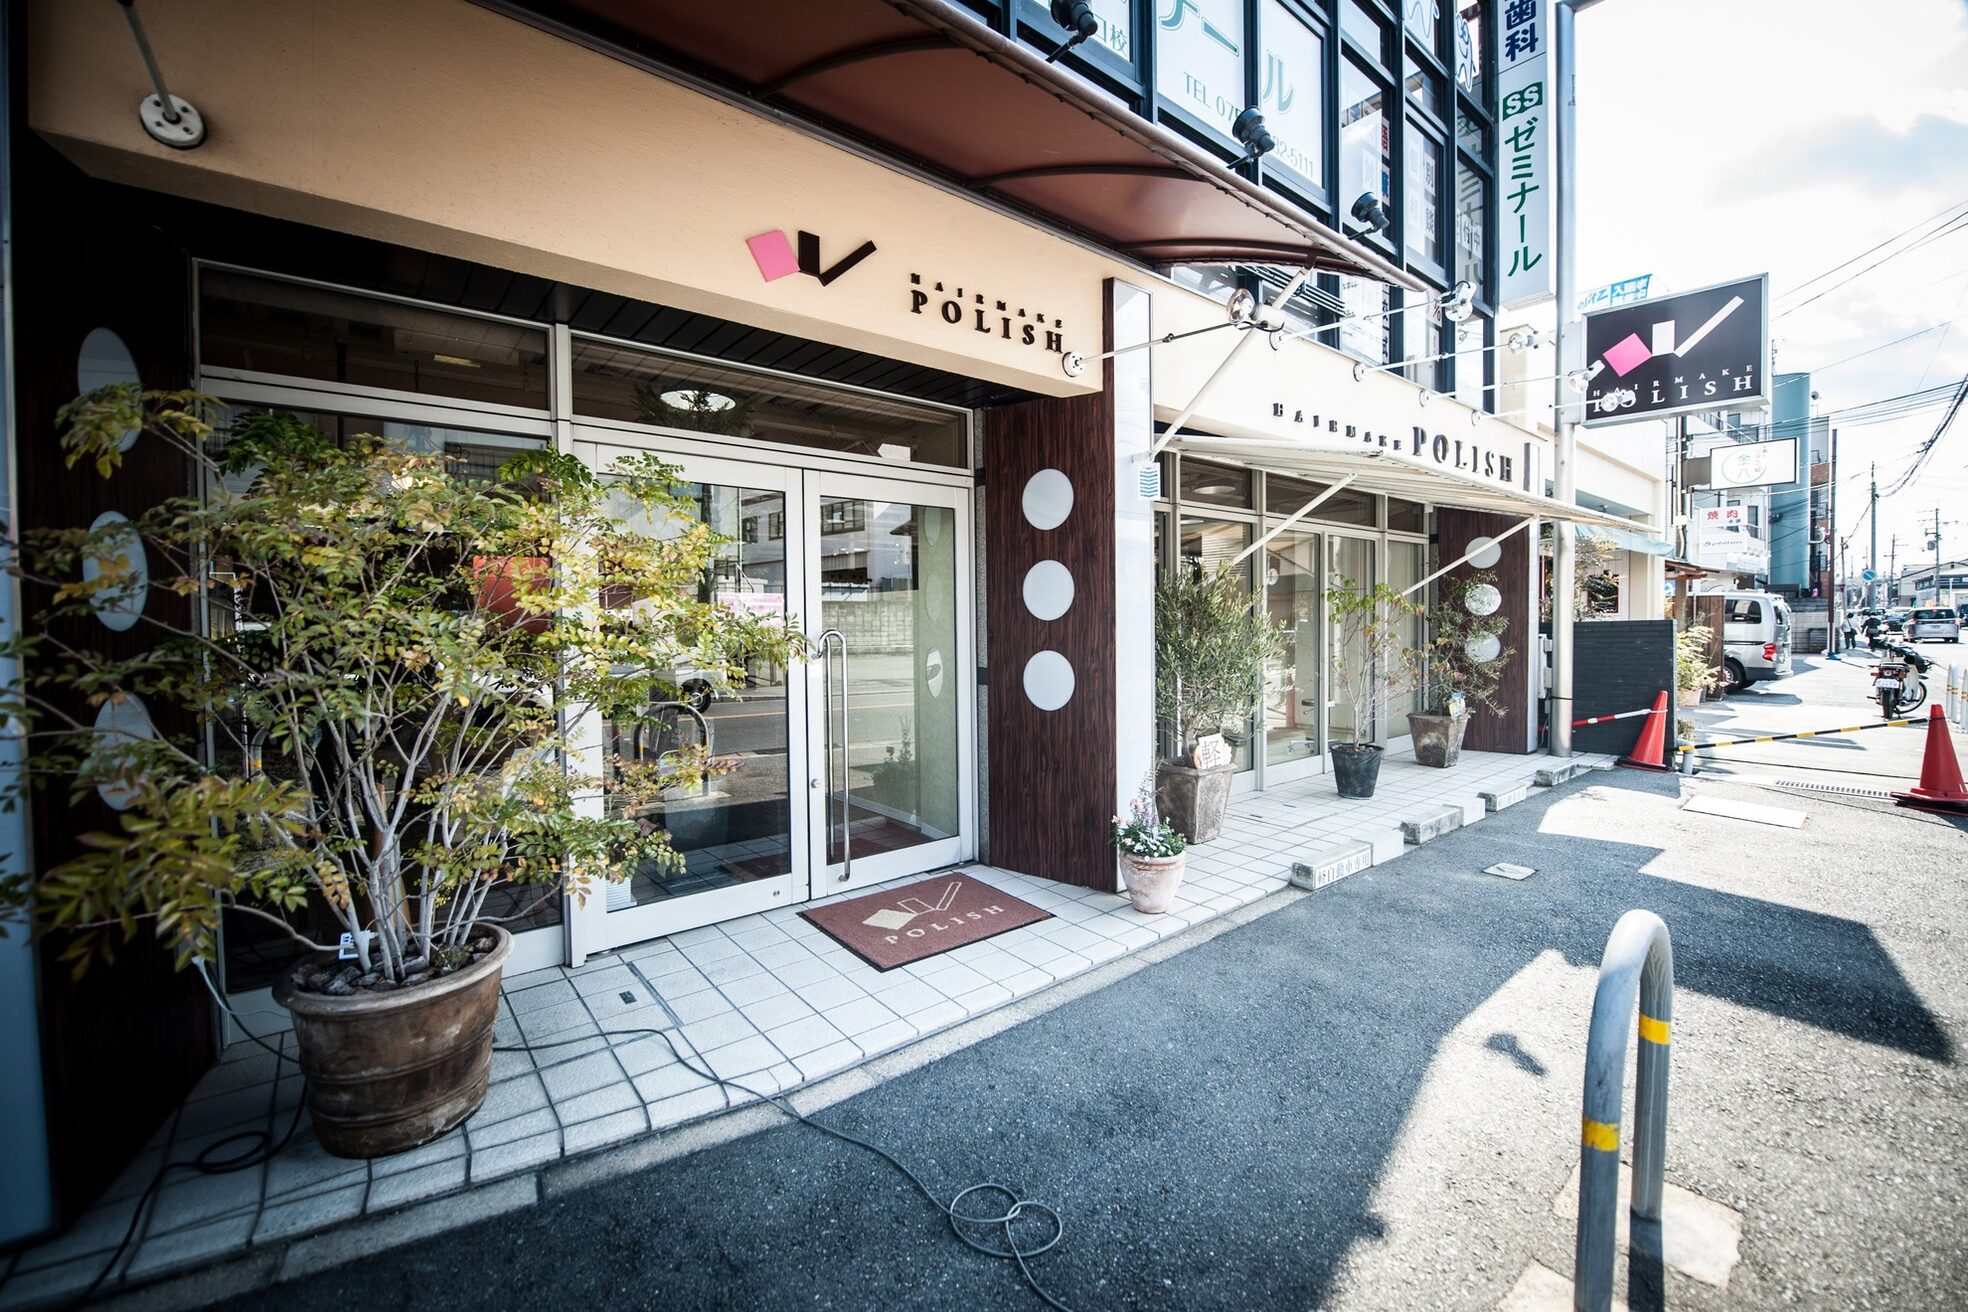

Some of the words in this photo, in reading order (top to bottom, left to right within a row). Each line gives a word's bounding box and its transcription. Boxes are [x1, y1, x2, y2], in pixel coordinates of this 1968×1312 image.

[1504, 0, 1539, 62] 歯科
[1183, 71, 1212, 109] TEL
[1504, 83, 1541, 117] SS
[1504, 116, 1543, 278] ゼミナール
[910, 272, 1063, 329] HAIRMAKE
[910, 289, 1063, 355] POLISH
[1592, 364, 1753, 397] HAIRMAKE
[1272, 402, 1402, 451] HAIRMAKE
[1412, 425, 1513, 482] POLISH
[884, 905, 1005, 945] POLISH
